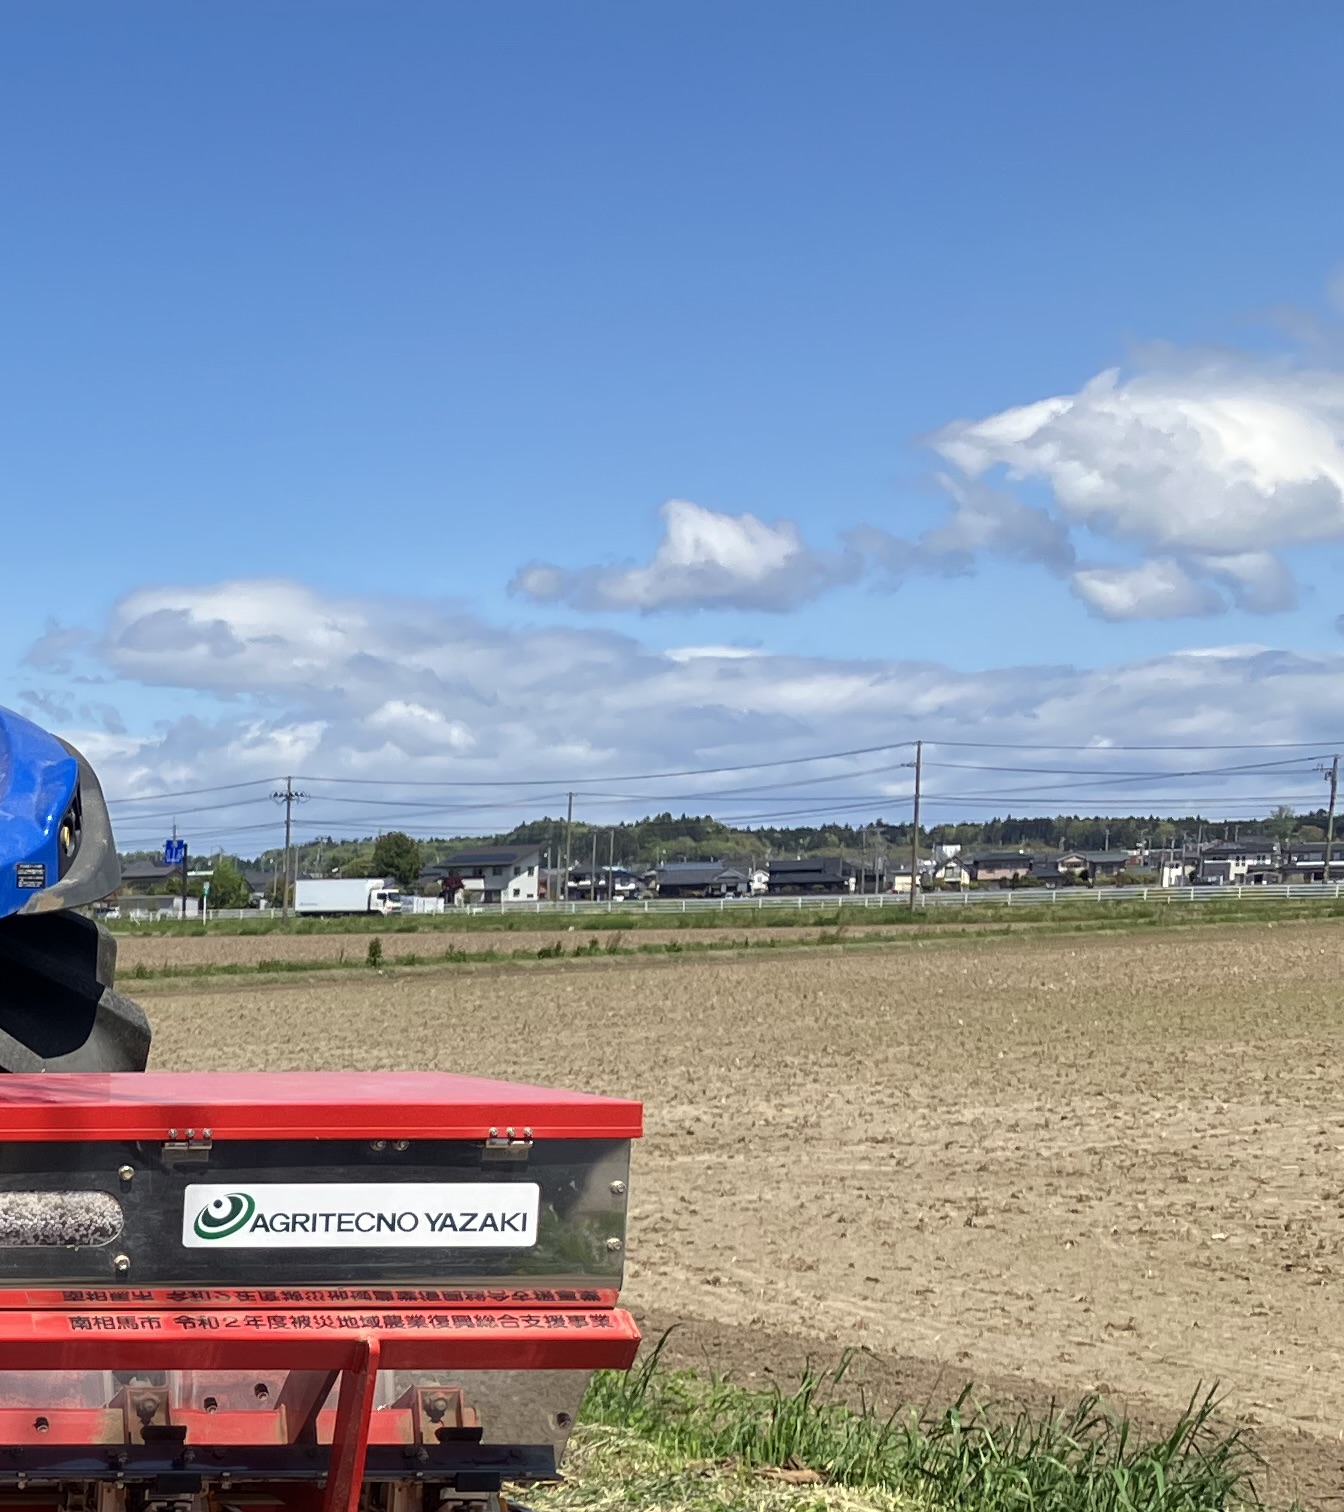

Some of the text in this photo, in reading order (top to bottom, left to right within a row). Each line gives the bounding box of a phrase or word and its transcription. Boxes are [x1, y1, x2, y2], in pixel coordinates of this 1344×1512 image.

[249, 1212, 528, 1233] AGRITECNO YAZAKI
[68, 1314, 615, 1331] 南相馬市 令和2年度被災地域農業復興総合支援事業
